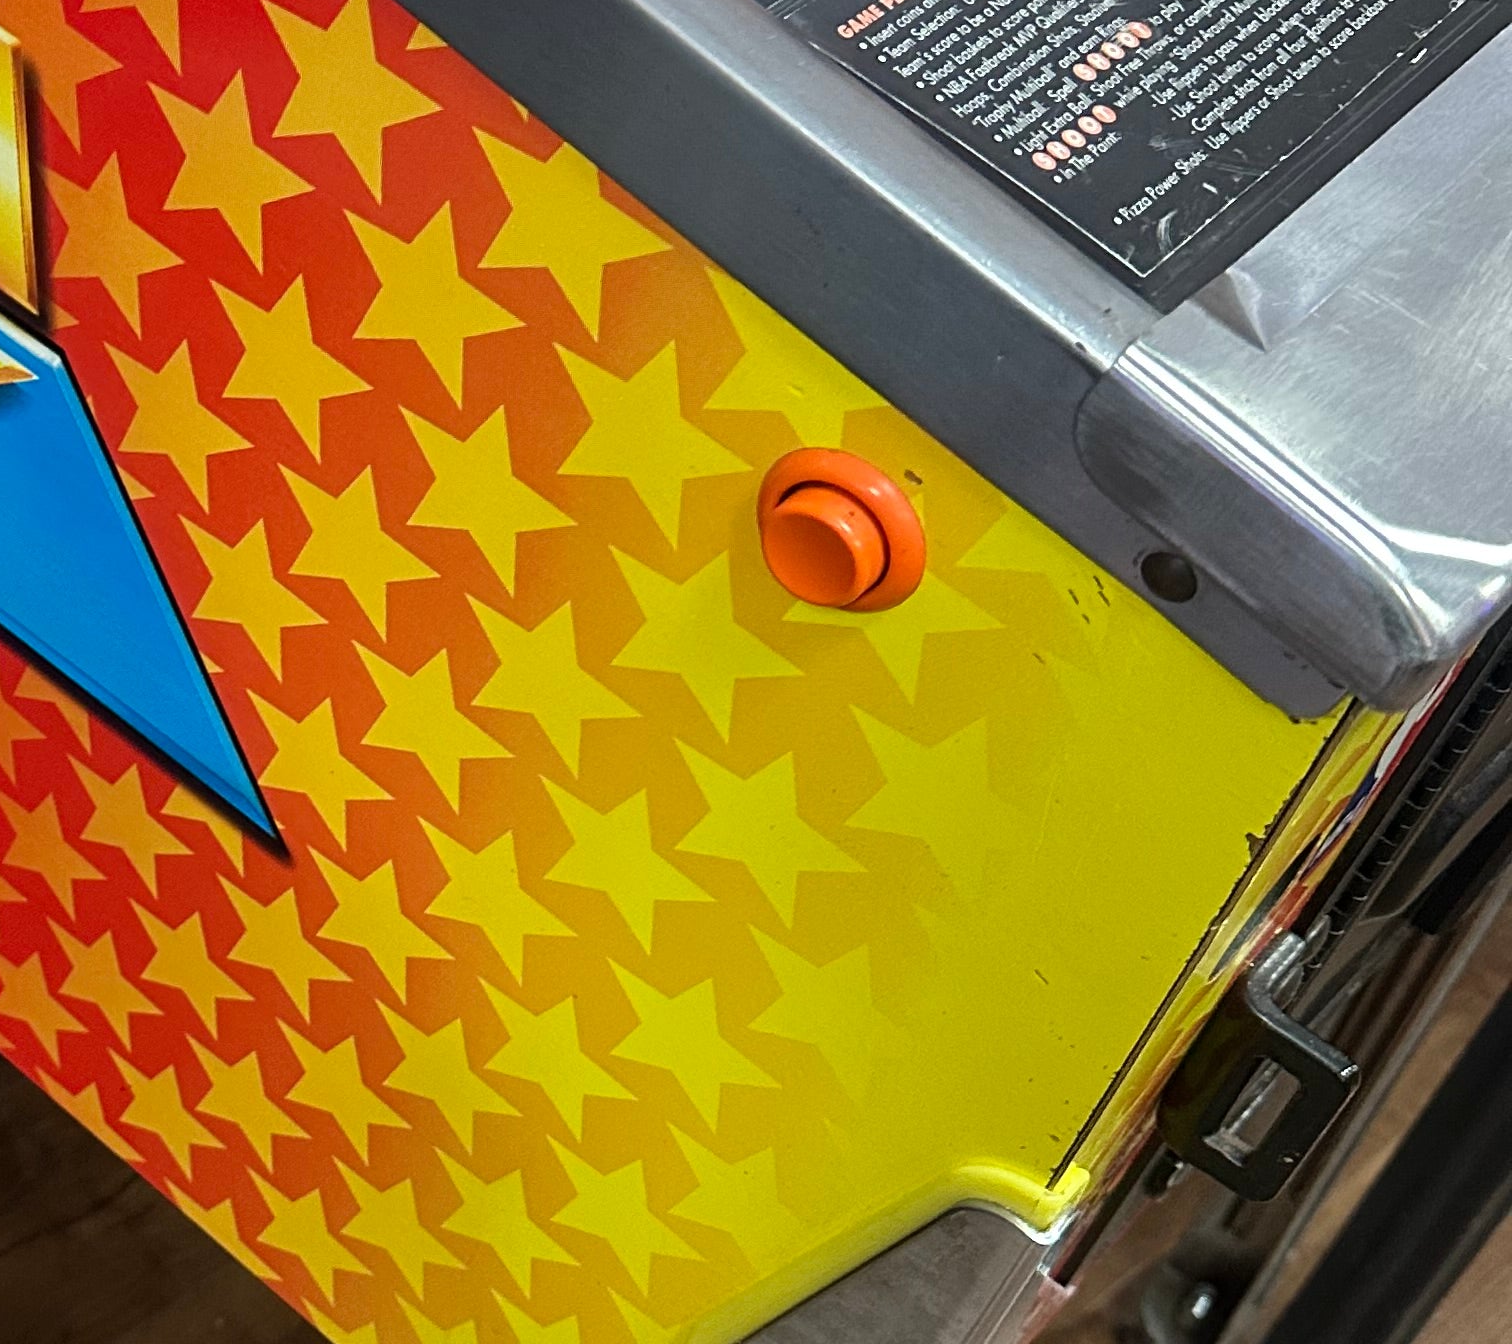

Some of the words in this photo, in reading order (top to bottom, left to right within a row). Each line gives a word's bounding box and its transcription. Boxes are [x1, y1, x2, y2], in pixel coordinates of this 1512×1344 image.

[983, 7, 995, 17] a
[1339, 0, 1354, 10] to
[837, 4, 885, 38] GAME
[865, 23, 898, 46] Insert
[896, 5, 925, 28] coins
[955, 24, 972, 36] to
[963, 14, 986, 27] be
[882, 38, 916, 58] Team
[922, 60, 957, 85] Shoot
[949, 35, 993, 65] baskets
[988, 27, 1004, 39] to
[1001, 8, 1030, 30] score
[930, 32, 961, 56] score
[1047, 76, 1078, 103] Spell
[1147, 15, 1163, 26] to
[1160, 0, 1185, 22] play
[1168, 63, 1208, 91] flippers
[1201, 55, 1218, 66] to
[1214, 39, 1239, 61] pass
[1234, 19, 1262, 41] when
[1275, 47, 1292, 65] all
[1283, 36, 1308, 54] four
[893, 51, 934, 78] Team's
[941, 76, 972, 99] NBA
[965, 42, 1018, 81] Fastbreak
[1012, 23, 1038, 47] MVP
[1058, 47, 1081, 69] and
[1113, 86, 1143, 108] while
[1139, 60, 1179, 92] playing
[1199, 9, 1236, 42] Around
[1188, 79, 1220, 104] Shoot
[1212, 60, 1247, 84] button
[1241, 52, 1257, 63] to
[1253, 32, 1280, 55] score
[1276, 13, 1304, 35] when
[951, 92, 994, 118] Hoops,
[987, 45, 1052, 92] Combination
[1251, 62, 1279, 81] from
[1019, 129, 1051, 156] Light
[1041, 112, 1074, 135] Extra
[1090, 71, 1123, 97] Shoot
[1115, 58, 1144, 77] Free
[1173, 23, 1186, 36] or
[1232, 78, 1260, 99] shots
[1118, 196, 1153, 221] Pizza
[1144, 172, 1180, 200] Power
[1204, 132, 1230, 150] Use
[1221, 106, 1261, 135] flippers
[1257, 96, 1271, 109] or
[1264, 75, 1296, 100] Shoot
[1287, 55, 1322, 80] button
[1315, 46, 1332, 58] to
[1328, 27, 1355, 50] score
[1346, 0, 1388, 30] backbox
[1058, 168, 1077, 180] In
[1068, 154, 1094, 171] The
